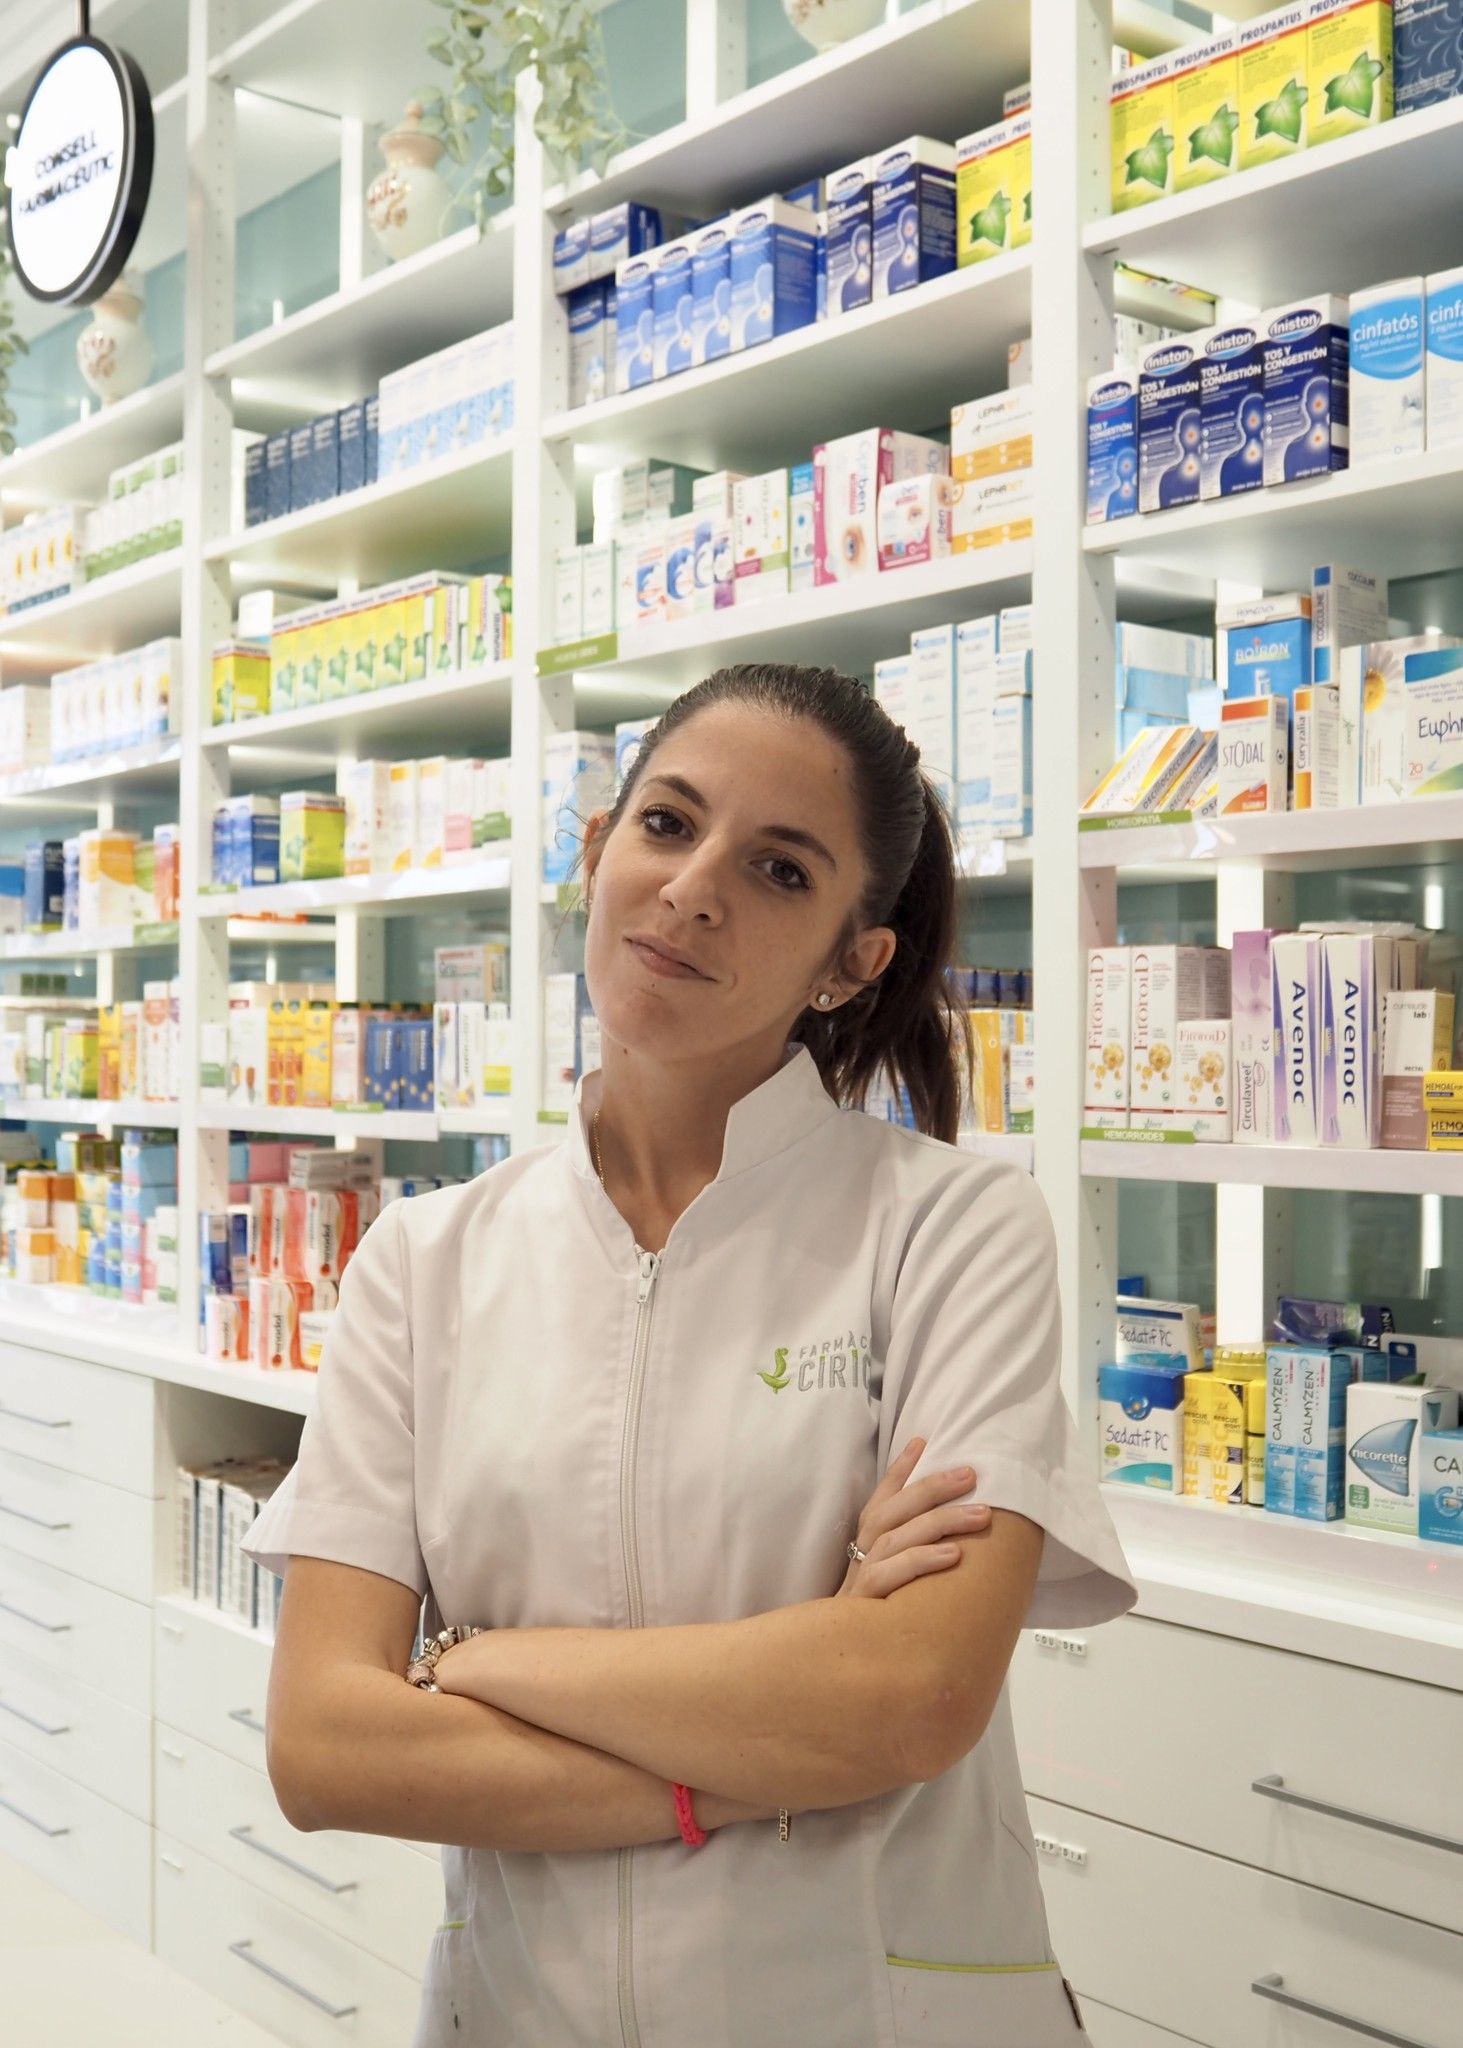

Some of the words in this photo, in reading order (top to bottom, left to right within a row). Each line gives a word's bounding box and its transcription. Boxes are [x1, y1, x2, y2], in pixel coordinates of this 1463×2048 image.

[1240, 11, 1303, 43] PROSPANTUS
[1174, 38, 1233, 69] PROSPANTUS
[1112, 64, 1168, 93] PROSPANTUS
[1353, 313, 1418, 342] cinfatós
[1264, 349, 1283, 361] TOS
[1284, 346, 1291, 356] Y
[1264, 347, 1327, 371] CONGESTIÓN
[1201, 366, 1219, 378] TOS
[1220, 363, 1228, 373] Y
[1201, 365, 1262, 389] CONGESTIÓN
[1141, 381, 1199, 404] CONGESTIÓN
[1235, 641, 1289, 662] BOIRON
[1222, 739, 1265, 769] STODAL
[1297, 716, 1306, 770] Coryzalia
[1408, 761, 1424, 777] 20
[1292, 980, 1306, 1105] Avenoc
[1343, 978, 1359, 1105] Avenoc
[1103, 1130, 1166, 1143] HEMORROIDES
[800, 1330, 868, 1359] FARMÀC
[1160, 1329, 1173, 1348] PC
[1272, 1367, 1283, 1442] CALMYZEN
[1302, 1370, 1315, 1446] CALMYZEN
[1154, 1431, 1168, 1452] PC
[1352, 1449, 1408, 1466] nicorette
[1434, 1455, 1462, 1475] CA
